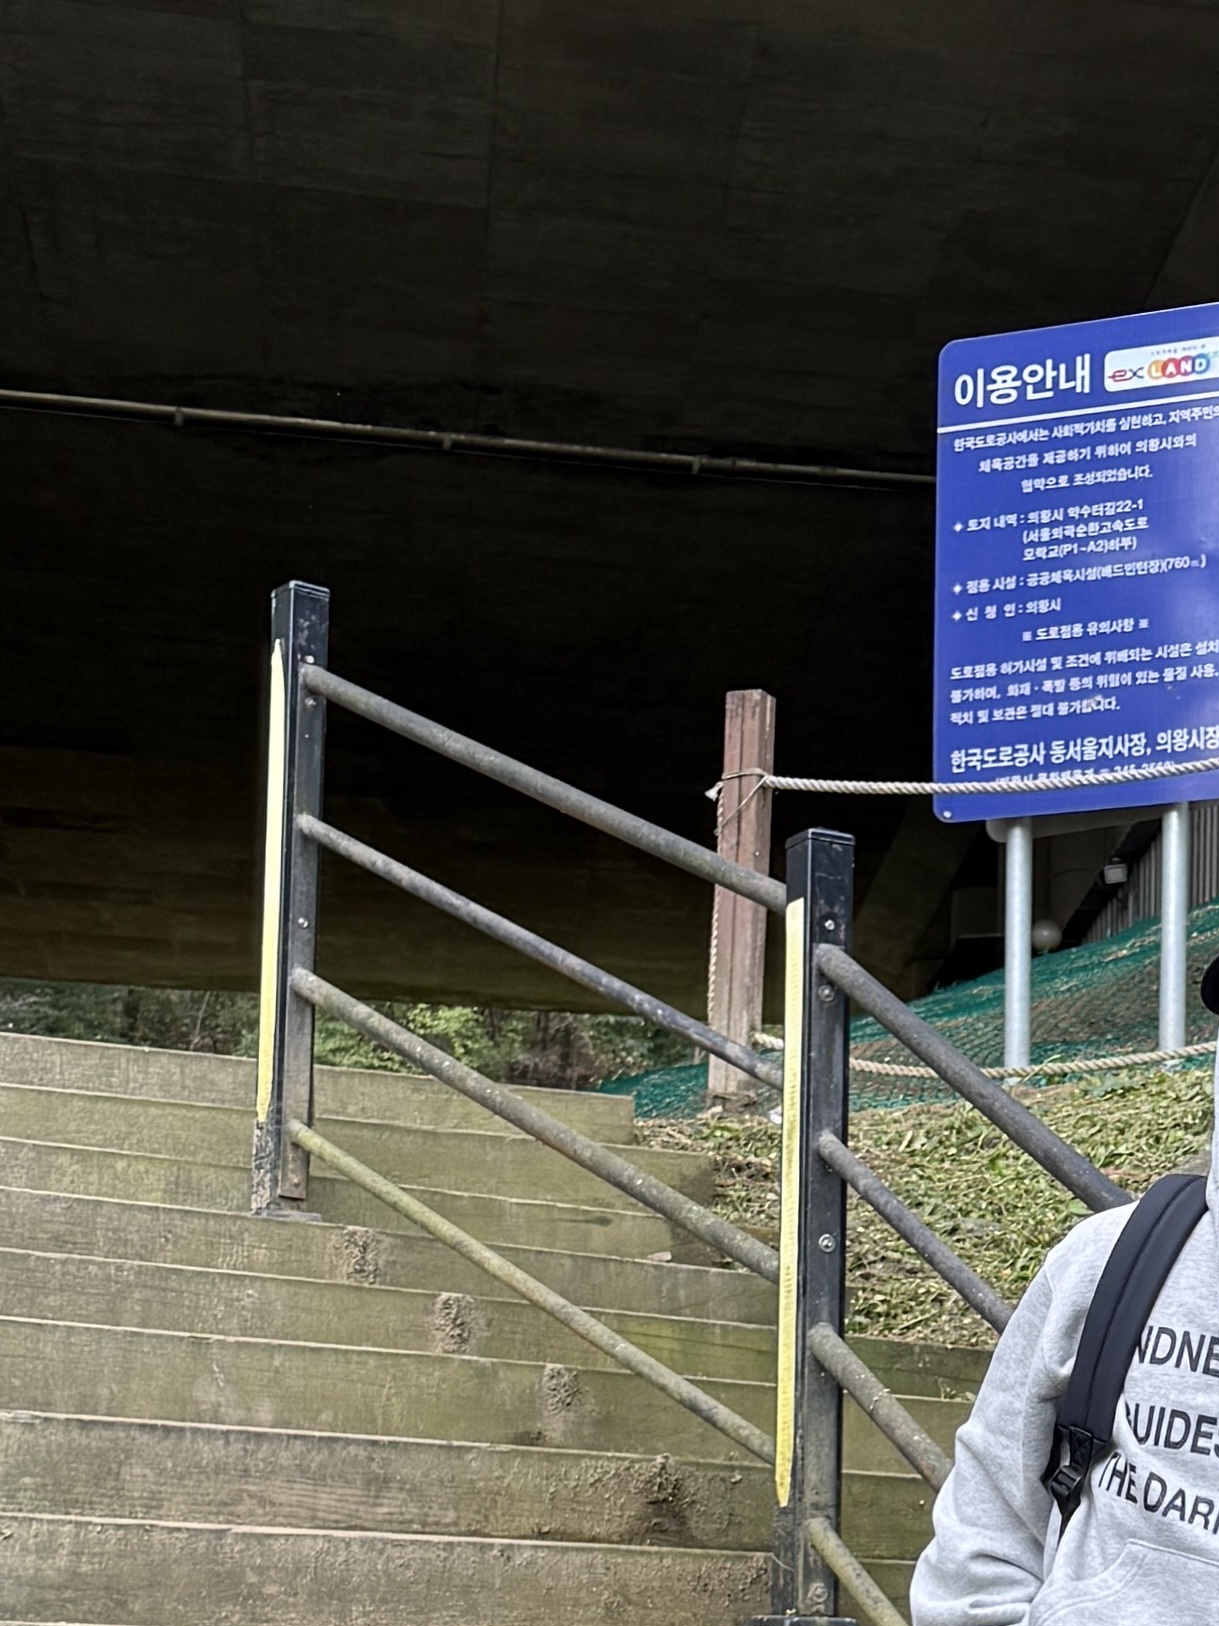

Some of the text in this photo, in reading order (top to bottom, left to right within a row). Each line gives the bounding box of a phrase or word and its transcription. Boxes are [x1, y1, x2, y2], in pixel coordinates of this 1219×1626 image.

[1148, 355, 1209, 379] LAND
[954, 353, 1091, 408] 이용안내
[954, 428, 1050, 452] 한국도로공사에서는
[1042, 446, 1091, 465] 제공하기
[1094, 441, 1132, 459] 위하여
[1021, 464, 1153, 493] 협약으로 조성되었습니다.
[966, 516, 991, 531] 토지
[1027, 508, 1064, 525] 의왕시
[992, 575, 1017, 591] 시설
[1025, 598, 1062, 614] 의왕시
[1035, 618, 1135, 641] 도로점용 유의사항
[950, 662, 998, 680] 도로점용
[1065, 651, 1102, 668] 조건에
[1155, 642, 1192, 659] 시설은
[1195, 639, 1219, 656] 설치
[1135, 669, 1160, 685] 있는
[991, 705, 1028, 721] 보관은
[950, 741, 1046, 774] 한국도로공사
[1049, 732, 1152, 764] 동서울지사장,
